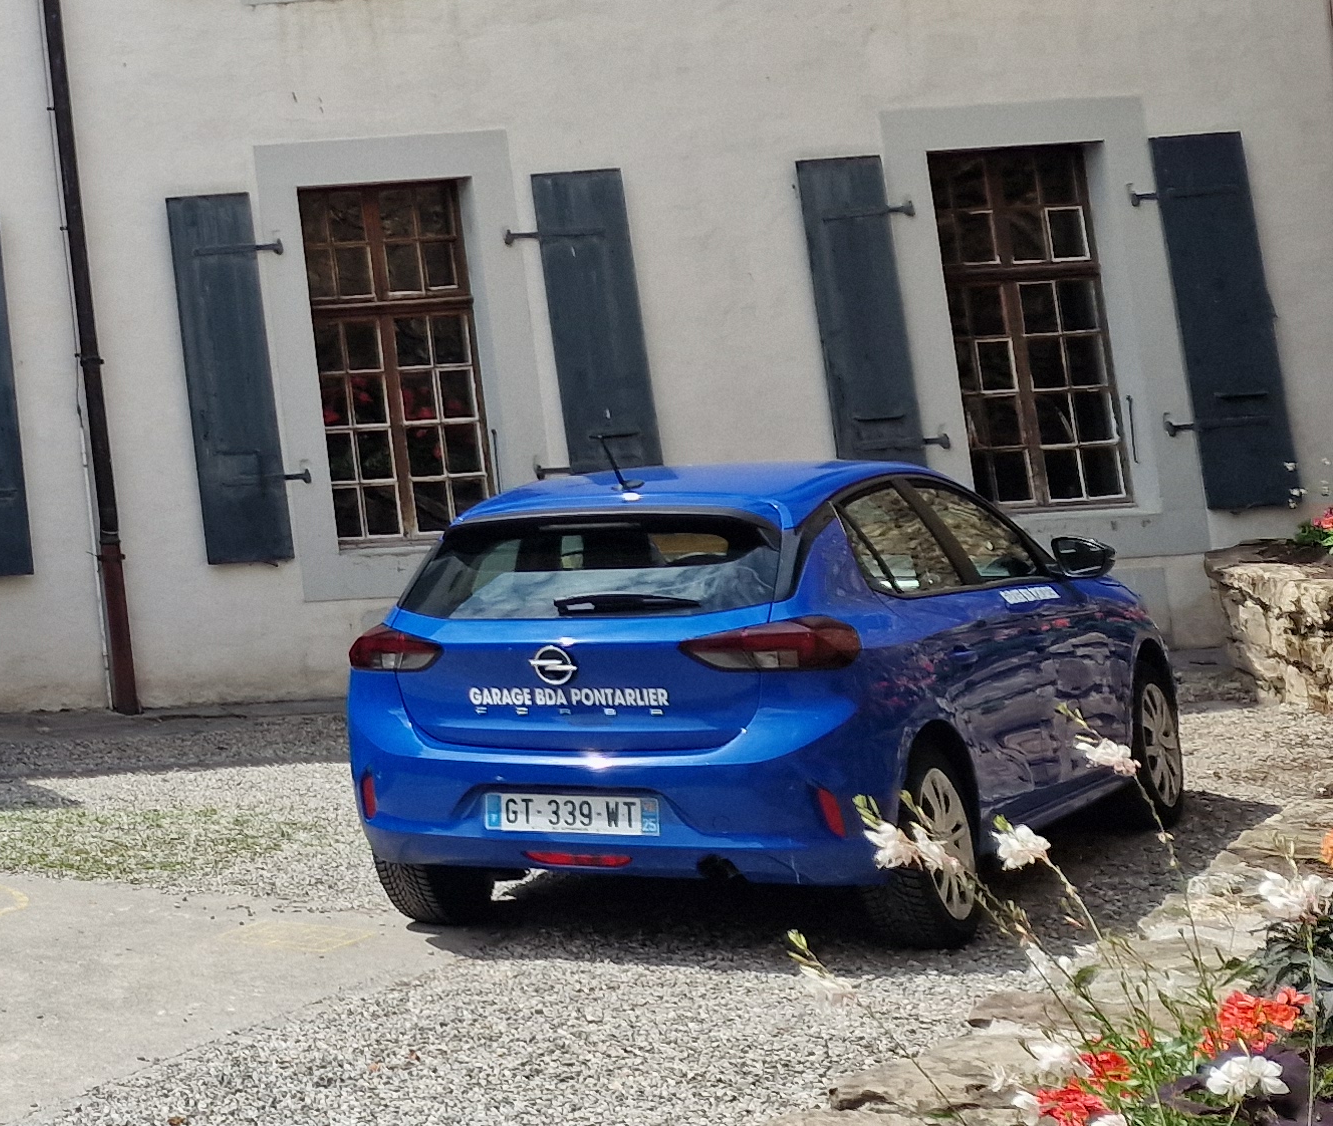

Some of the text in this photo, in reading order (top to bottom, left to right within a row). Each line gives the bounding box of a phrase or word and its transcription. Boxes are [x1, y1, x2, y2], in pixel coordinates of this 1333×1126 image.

[469, 687, 670, 706] GARAGE BDA PONTARLIER
[642, 818, 657, 832] 25
